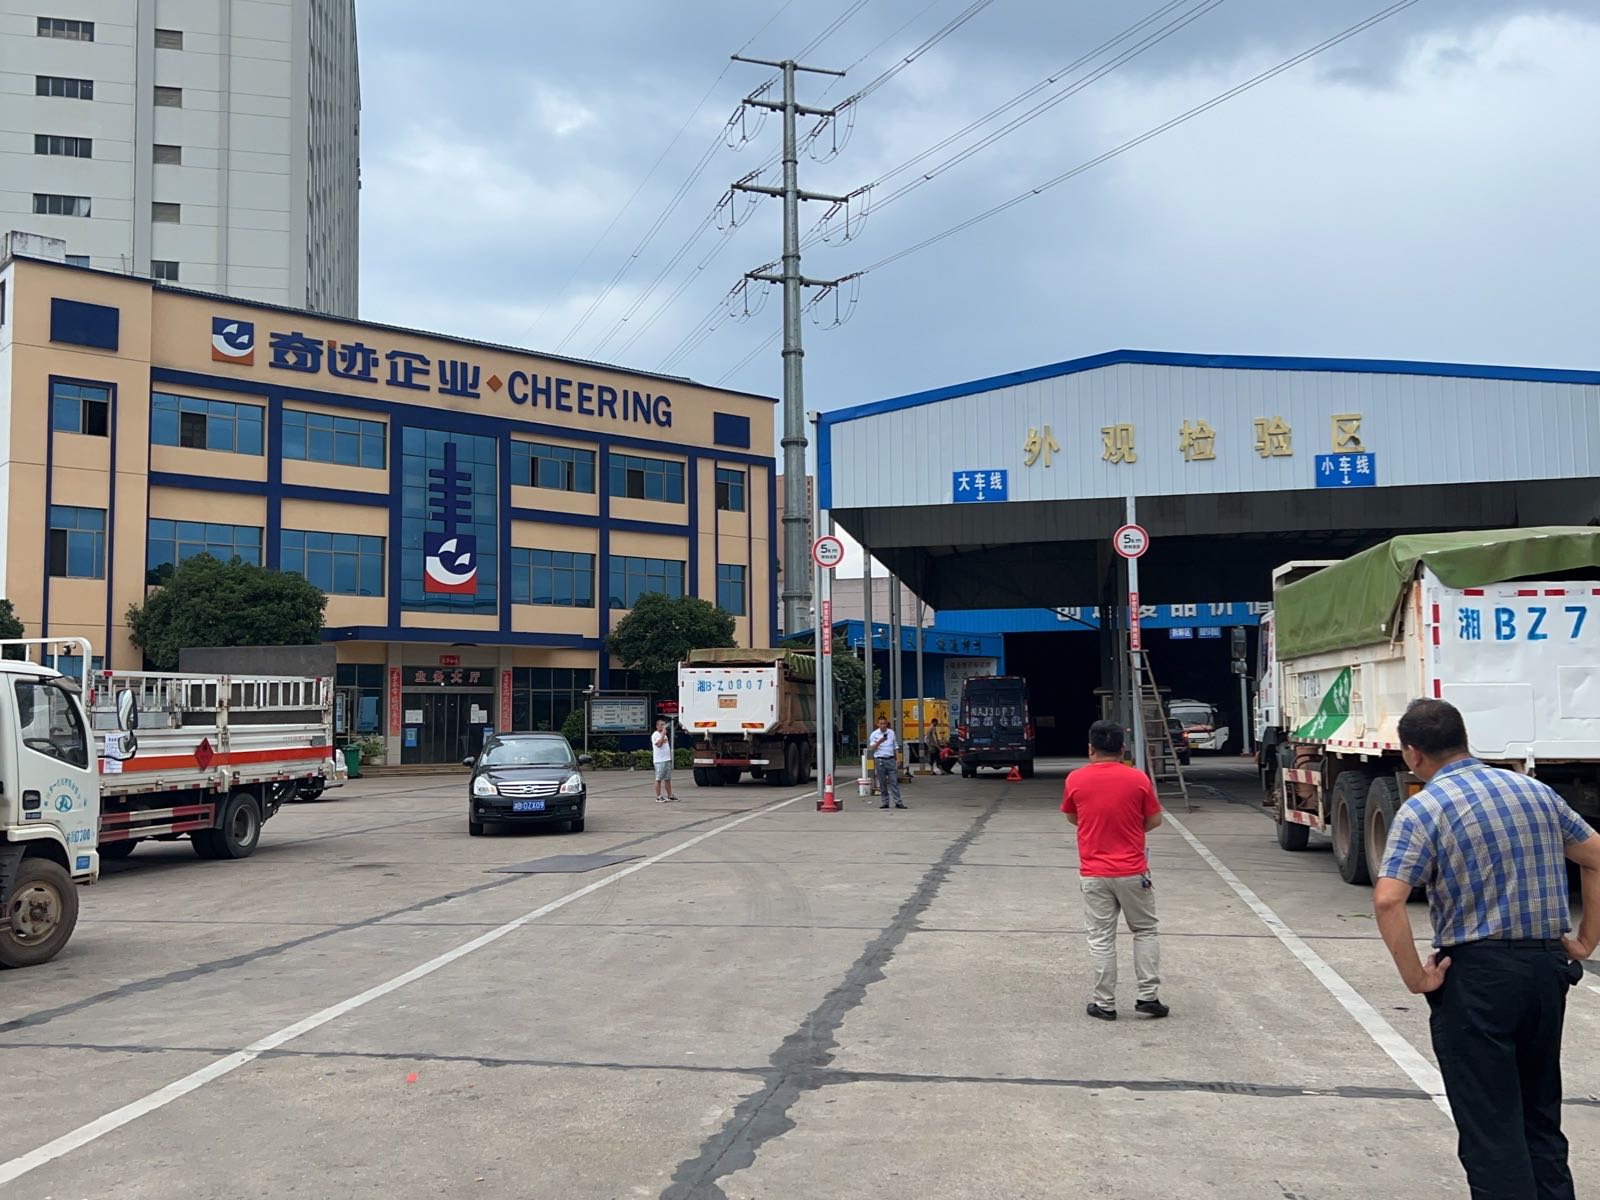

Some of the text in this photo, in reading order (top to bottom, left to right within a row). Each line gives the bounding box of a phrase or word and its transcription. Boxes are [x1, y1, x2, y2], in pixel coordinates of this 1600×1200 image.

[268, 331, 672, 428] 奇迹企业 CHEERING
[1023, 413, 1366, 468] 外观检验区
[1321, 455, 1370, 475] 小车线
[958, 472, 1003, 491] 大车线
[414, 670, 481, 683] 业务大厅
